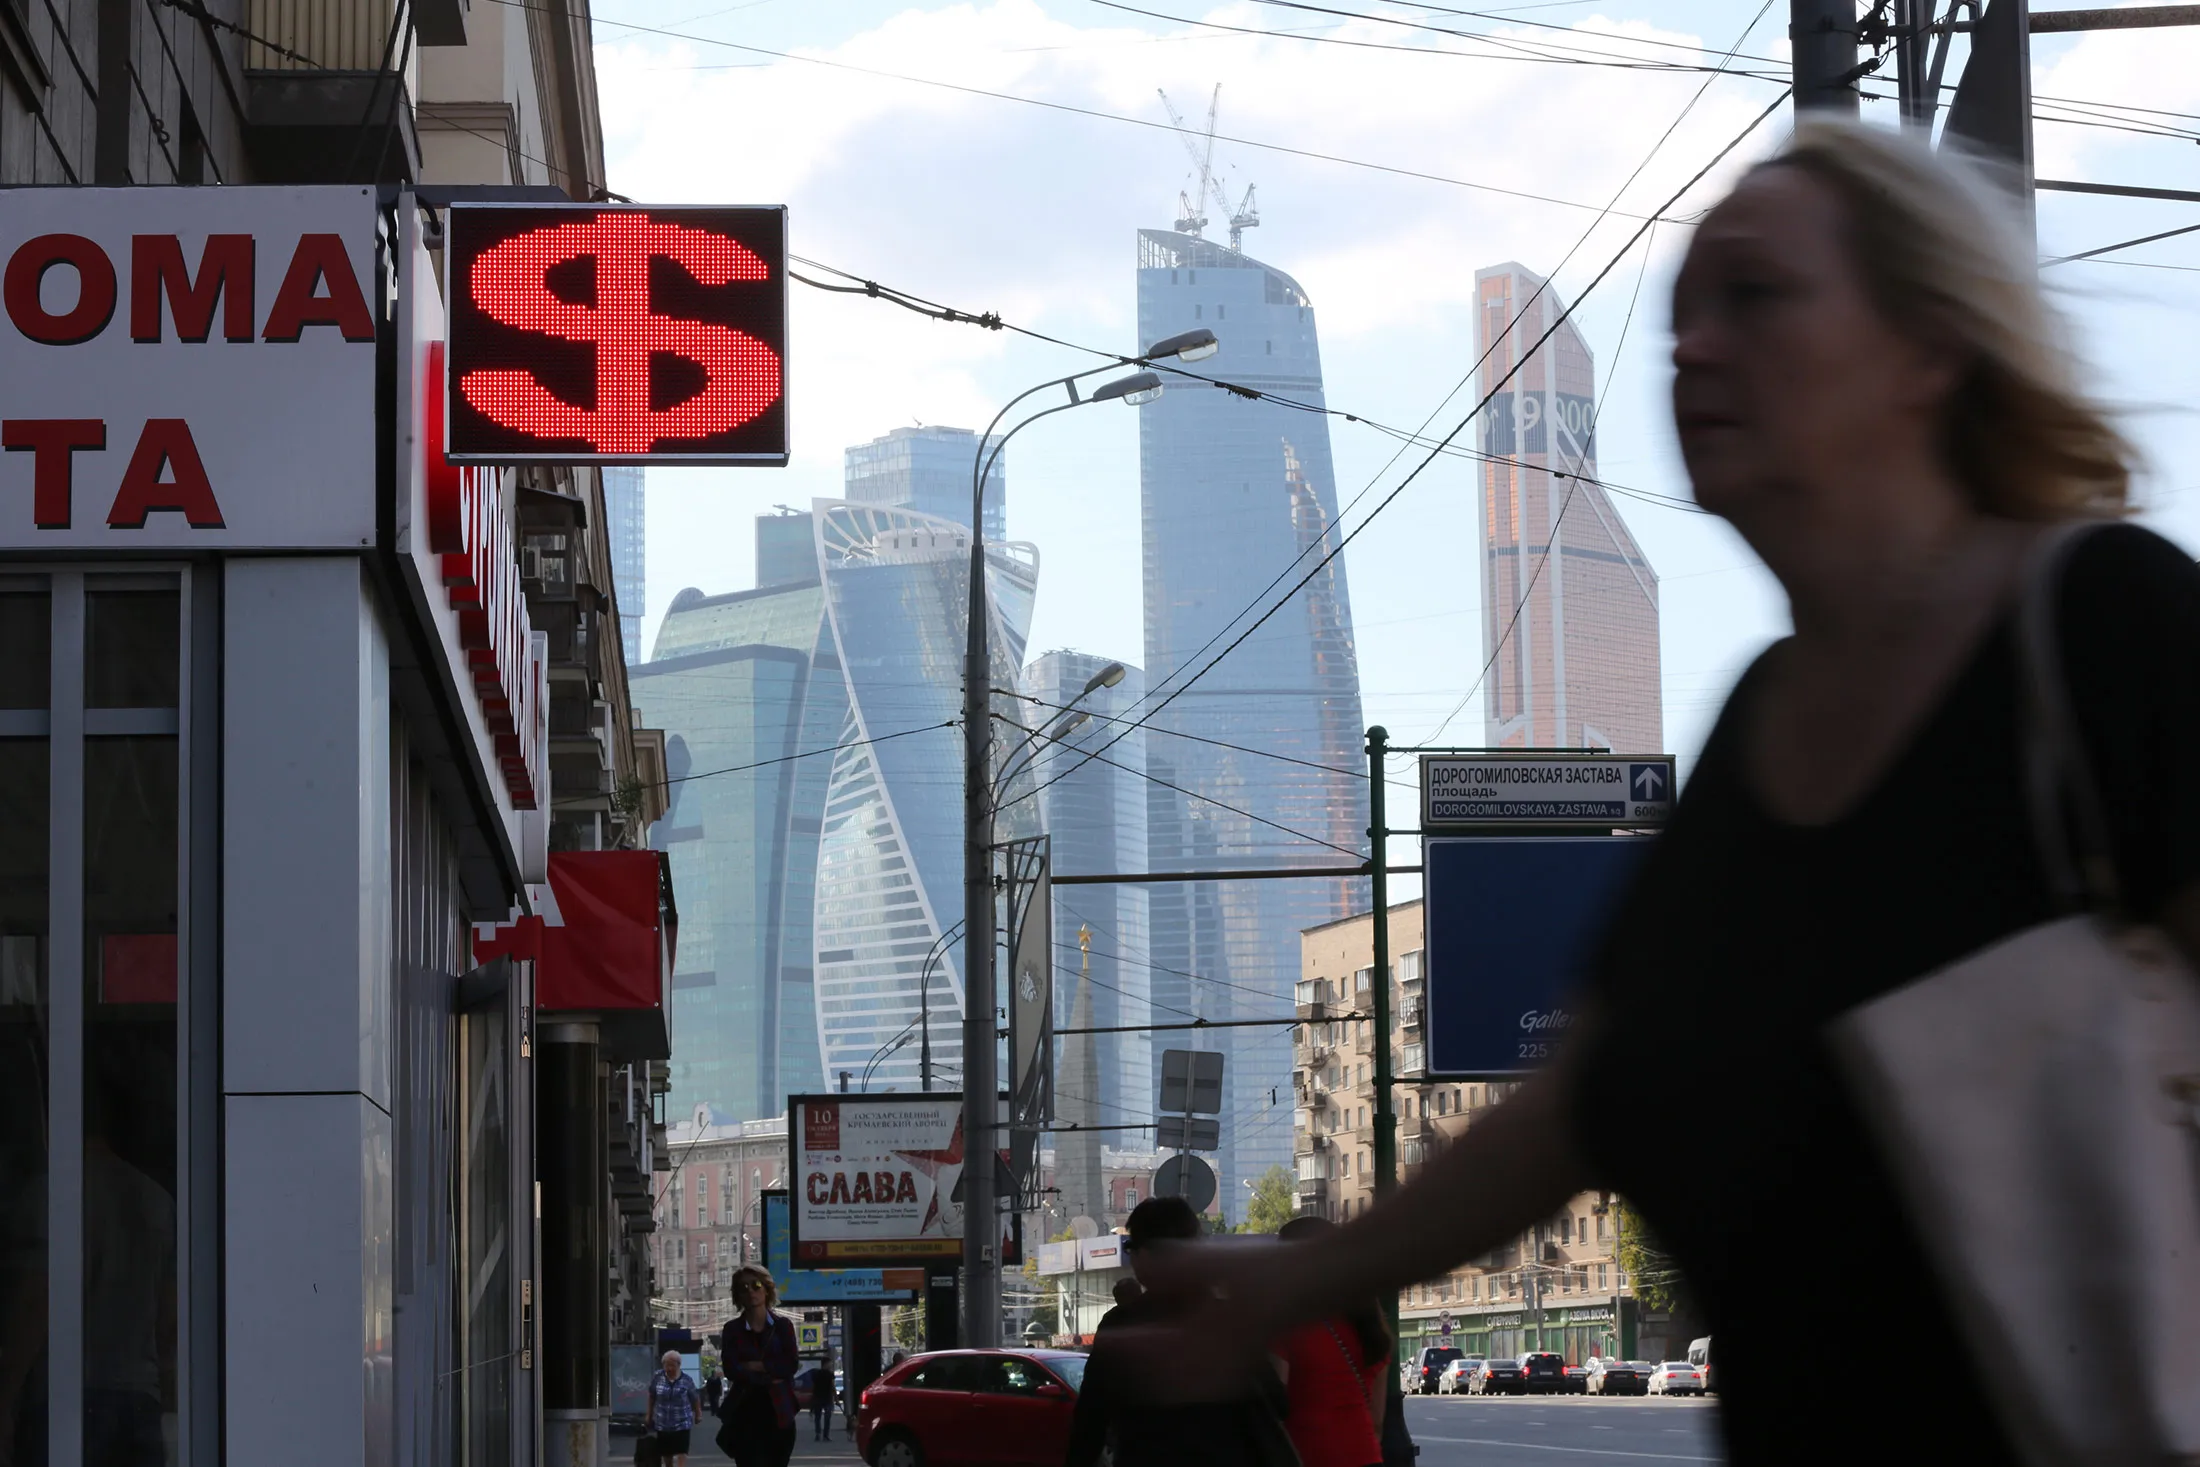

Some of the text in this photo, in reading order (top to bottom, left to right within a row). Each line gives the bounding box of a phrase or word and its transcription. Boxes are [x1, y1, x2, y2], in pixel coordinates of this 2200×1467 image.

[461, 213, 780, 453] $
[1432, 767, 1623, 786] ДОРОГОМИЛОВСКАЯ ЗАСТАВА
[1432, 786, 1498, 798] площадь
[1435, 803, 1556, 816] DOROGOMILOVSKAYA
[1558, 803, 1608, 815] ZASTAVA
[1519, 1009, 1577, 1033] Galler
[1518, 1043, 1548, 1059] 225
[813, 1109, 832, 1125] 10
[806, 1171, 918, 1205] СЛАВА
